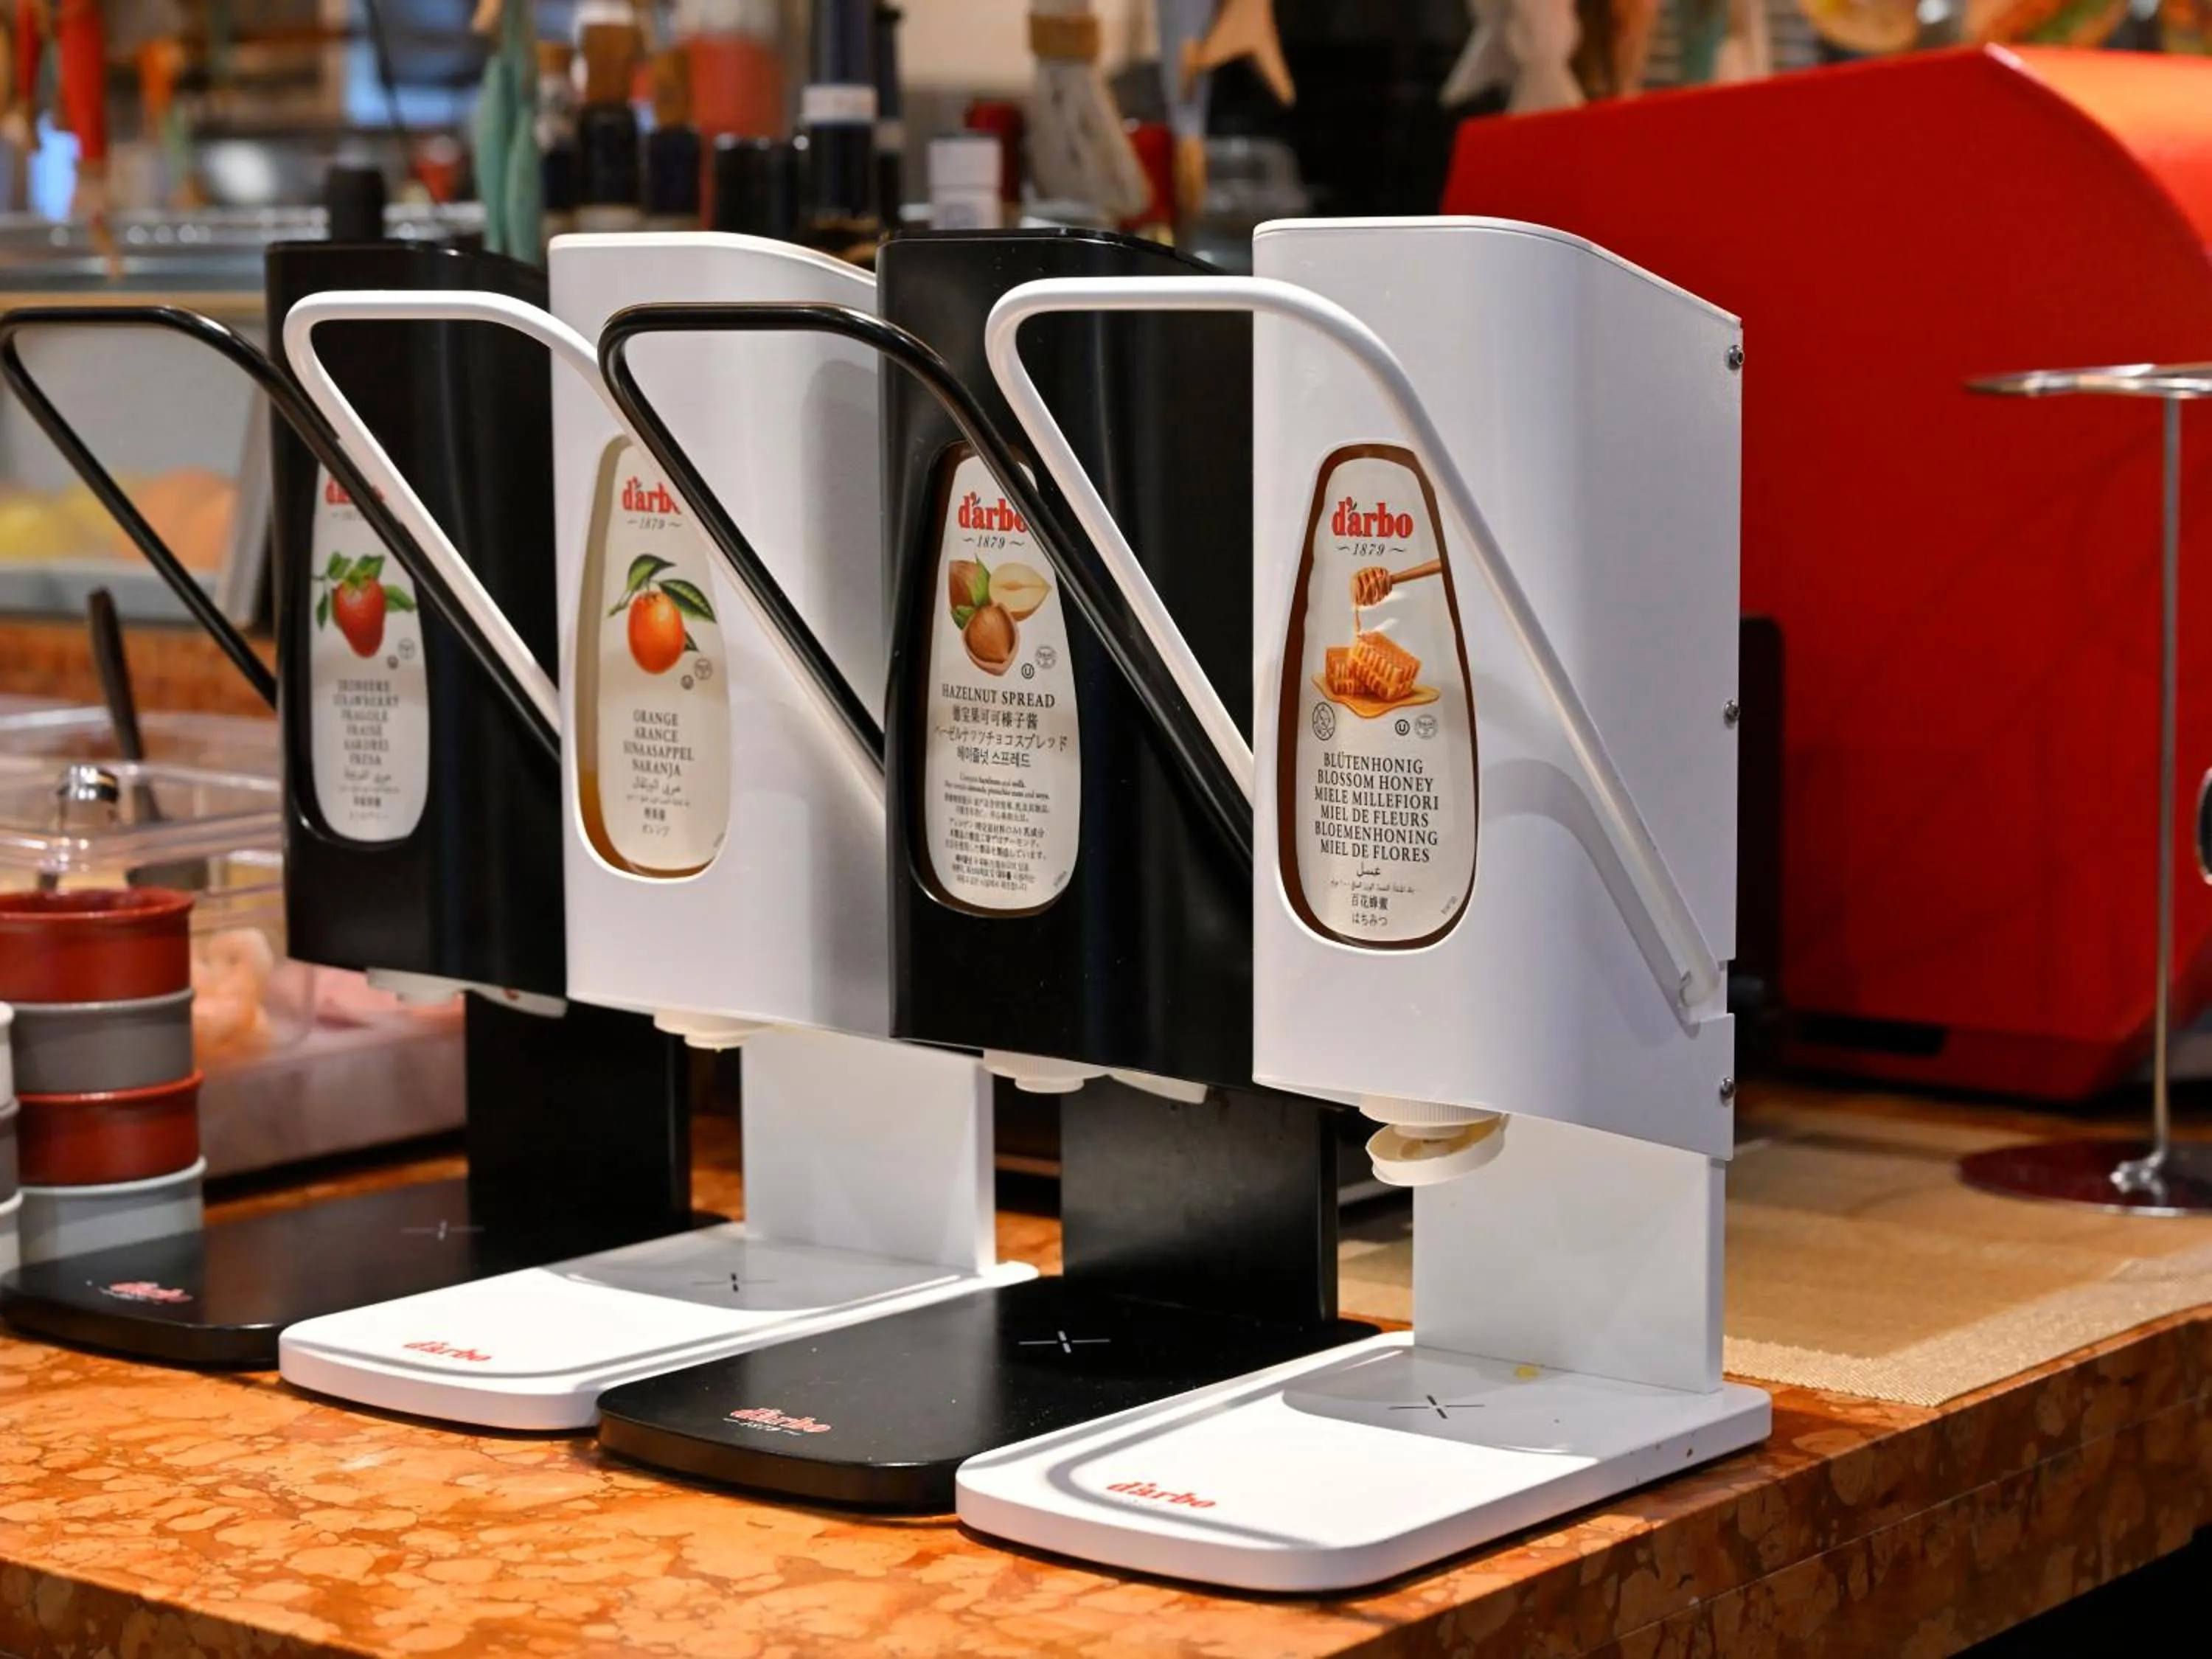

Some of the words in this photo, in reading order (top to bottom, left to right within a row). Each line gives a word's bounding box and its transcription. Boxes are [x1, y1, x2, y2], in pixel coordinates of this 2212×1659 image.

[977, 535, 1005, 549] 1879
[1352, 543, 1385, 556] 1879
[942, 684, 996, 703] HAZELNUT
[1001, 691, 1055, 708] SPREAD
[633, 709, 679, 726] ORANGE
[632, 758, 682, 778] NARANJA
[992, 751, 1031, 768] 스프레드
[1324, 751, 1424, 775] BLÜTENHONIG
[1318, 769, 1374, 789] BLOSSOM
[1380, 775, 1433, 793] HONEY
[1315, 786, 1348, 804] MIELE
[1352, 790, 1439, 810] MILLEFIORI
[1321, 804, 1348, 821] MIEL
[1352, 807, 1369, 824] DE
[1374, 810, 1429, 827] FLEURS
[1315, 821, 1438, 846] BLOEMENHONING
[1321, 839, 1348, 856] MIEL
[1352, 843, 1369, 858] DE
[1373, 845, 1430, 863] FLORES
[1357, 862, 1381, 877] عسل
[1352, 913, 1388, 926] はちみつ
